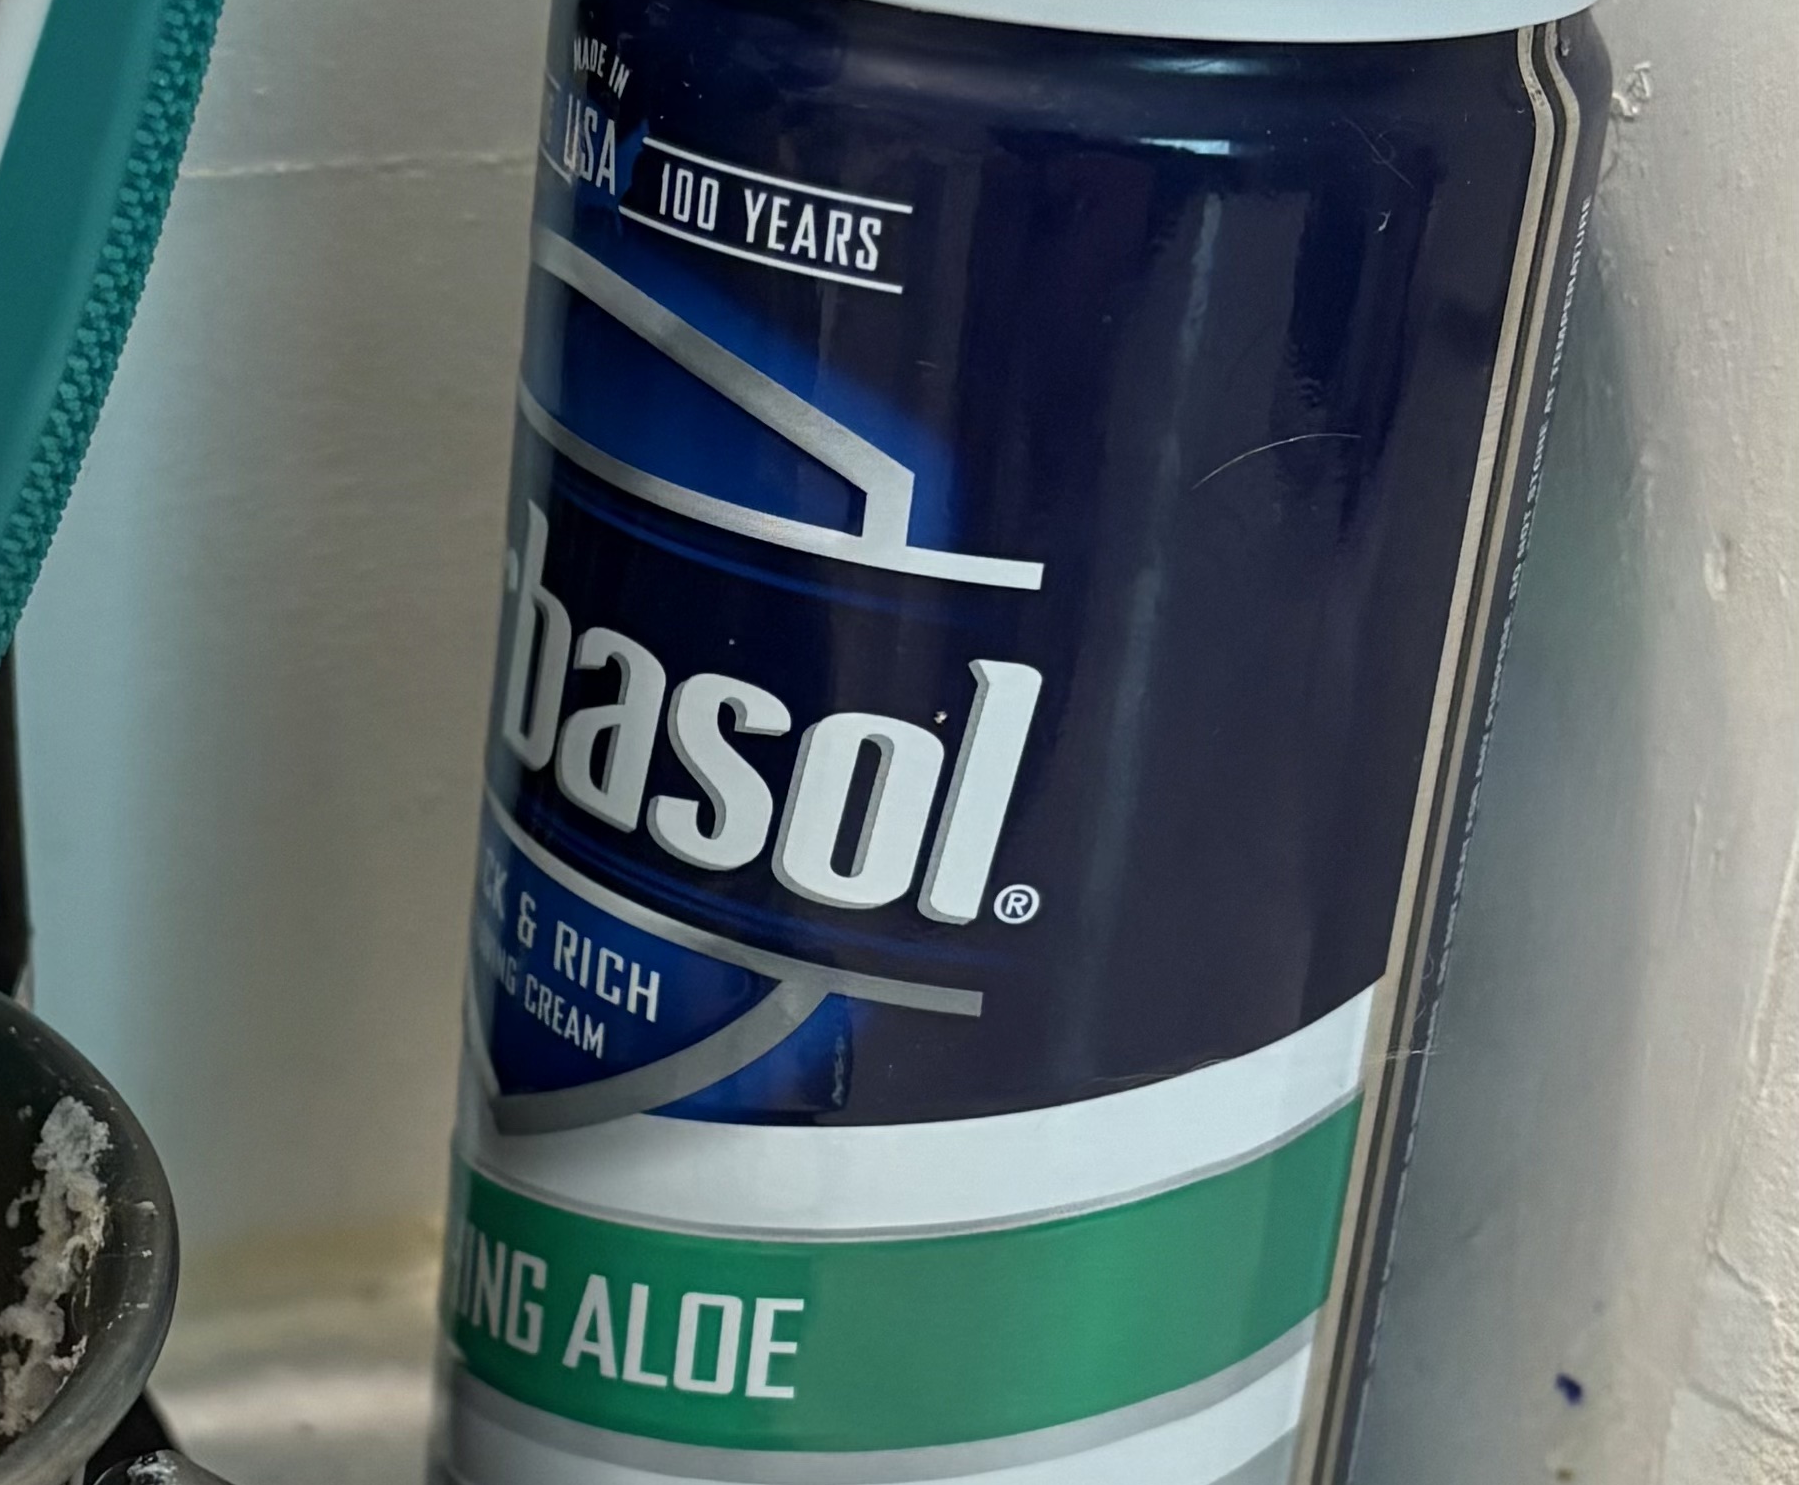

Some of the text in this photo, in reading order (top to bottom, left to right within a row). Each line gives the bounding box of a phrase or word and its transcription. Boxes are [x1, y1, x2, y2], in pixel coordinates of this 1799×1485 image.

[572, 35, 631, 100] MADE IN
[563, 92, 616, 197] USA
[658, 161, 883, 272] 100 YEARS
[516, 890, 538, 950] &
[553, 919, 661, 1024] RICH
[523, 972, 606, 1060] CREAM
[561, 1272, 805, 1399] ALOE
